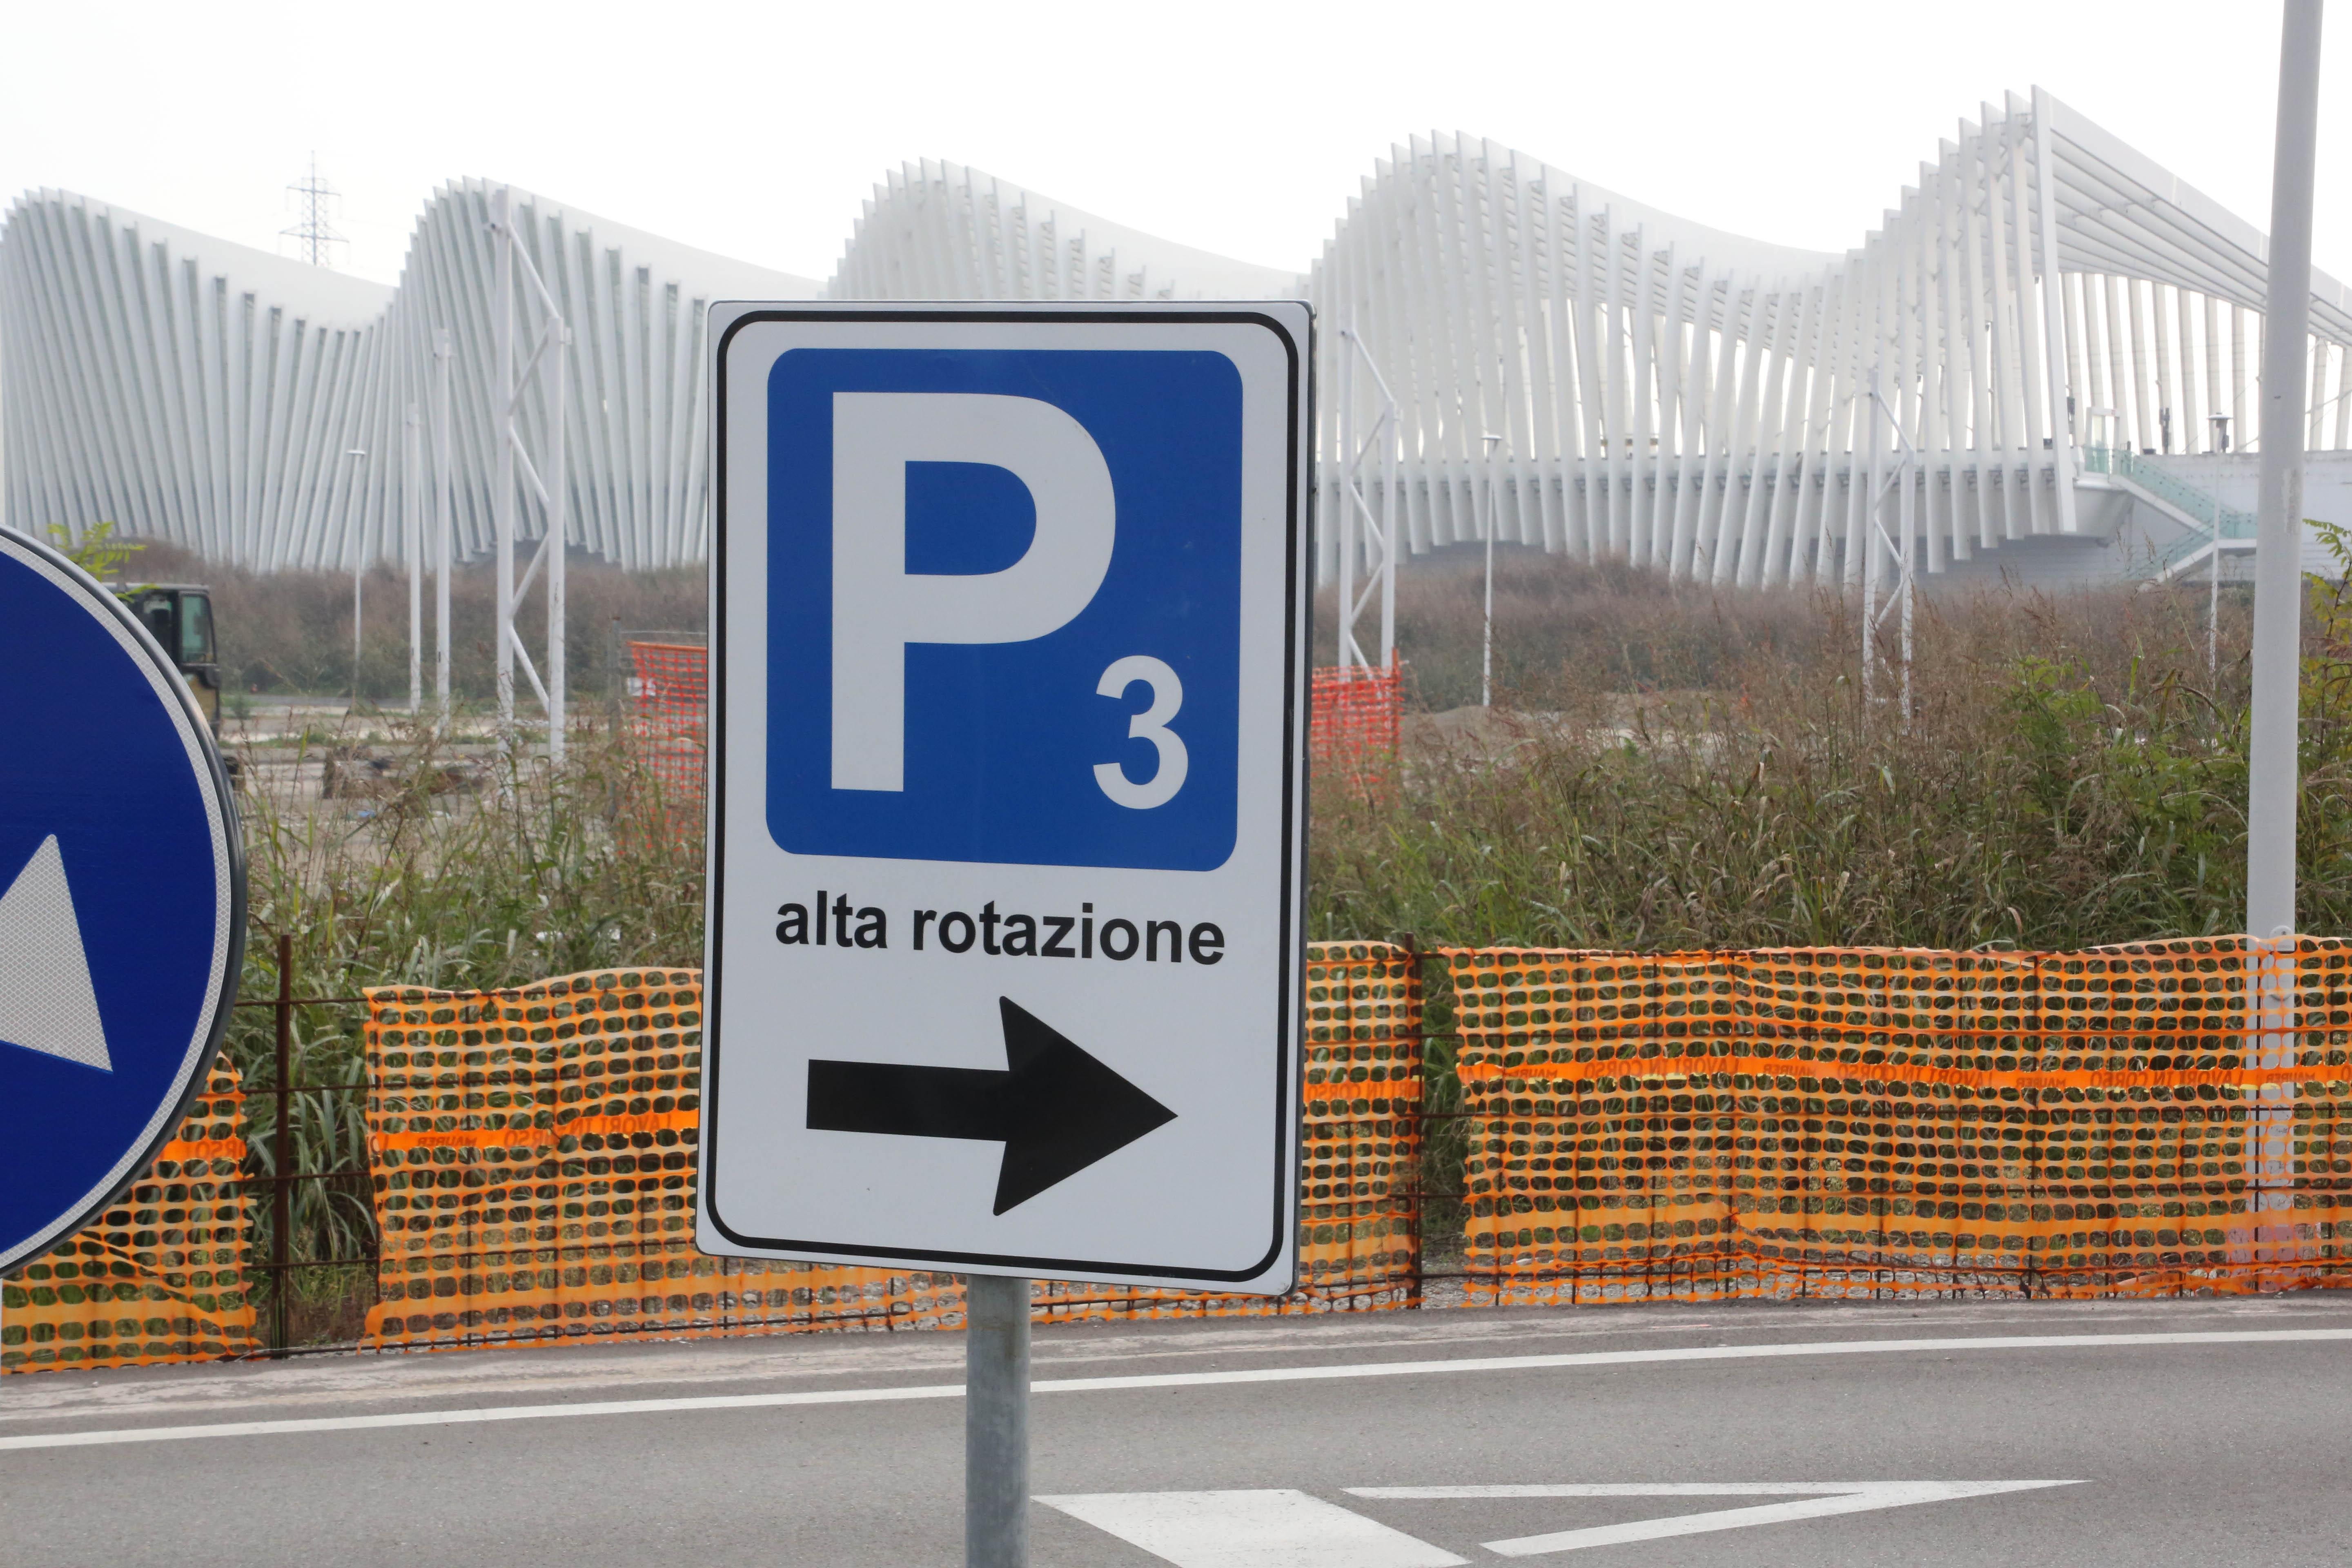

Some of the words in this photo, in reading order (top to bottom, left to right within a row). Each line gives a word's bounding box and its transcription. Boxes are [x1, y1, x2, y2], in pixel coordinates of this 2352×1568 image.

[831, 391, 1116, 792] P
[1093, 655, 1189, 810] 3
[775, 890, 888, 949] alta
[913, 900, 1225, 965] rotazione
